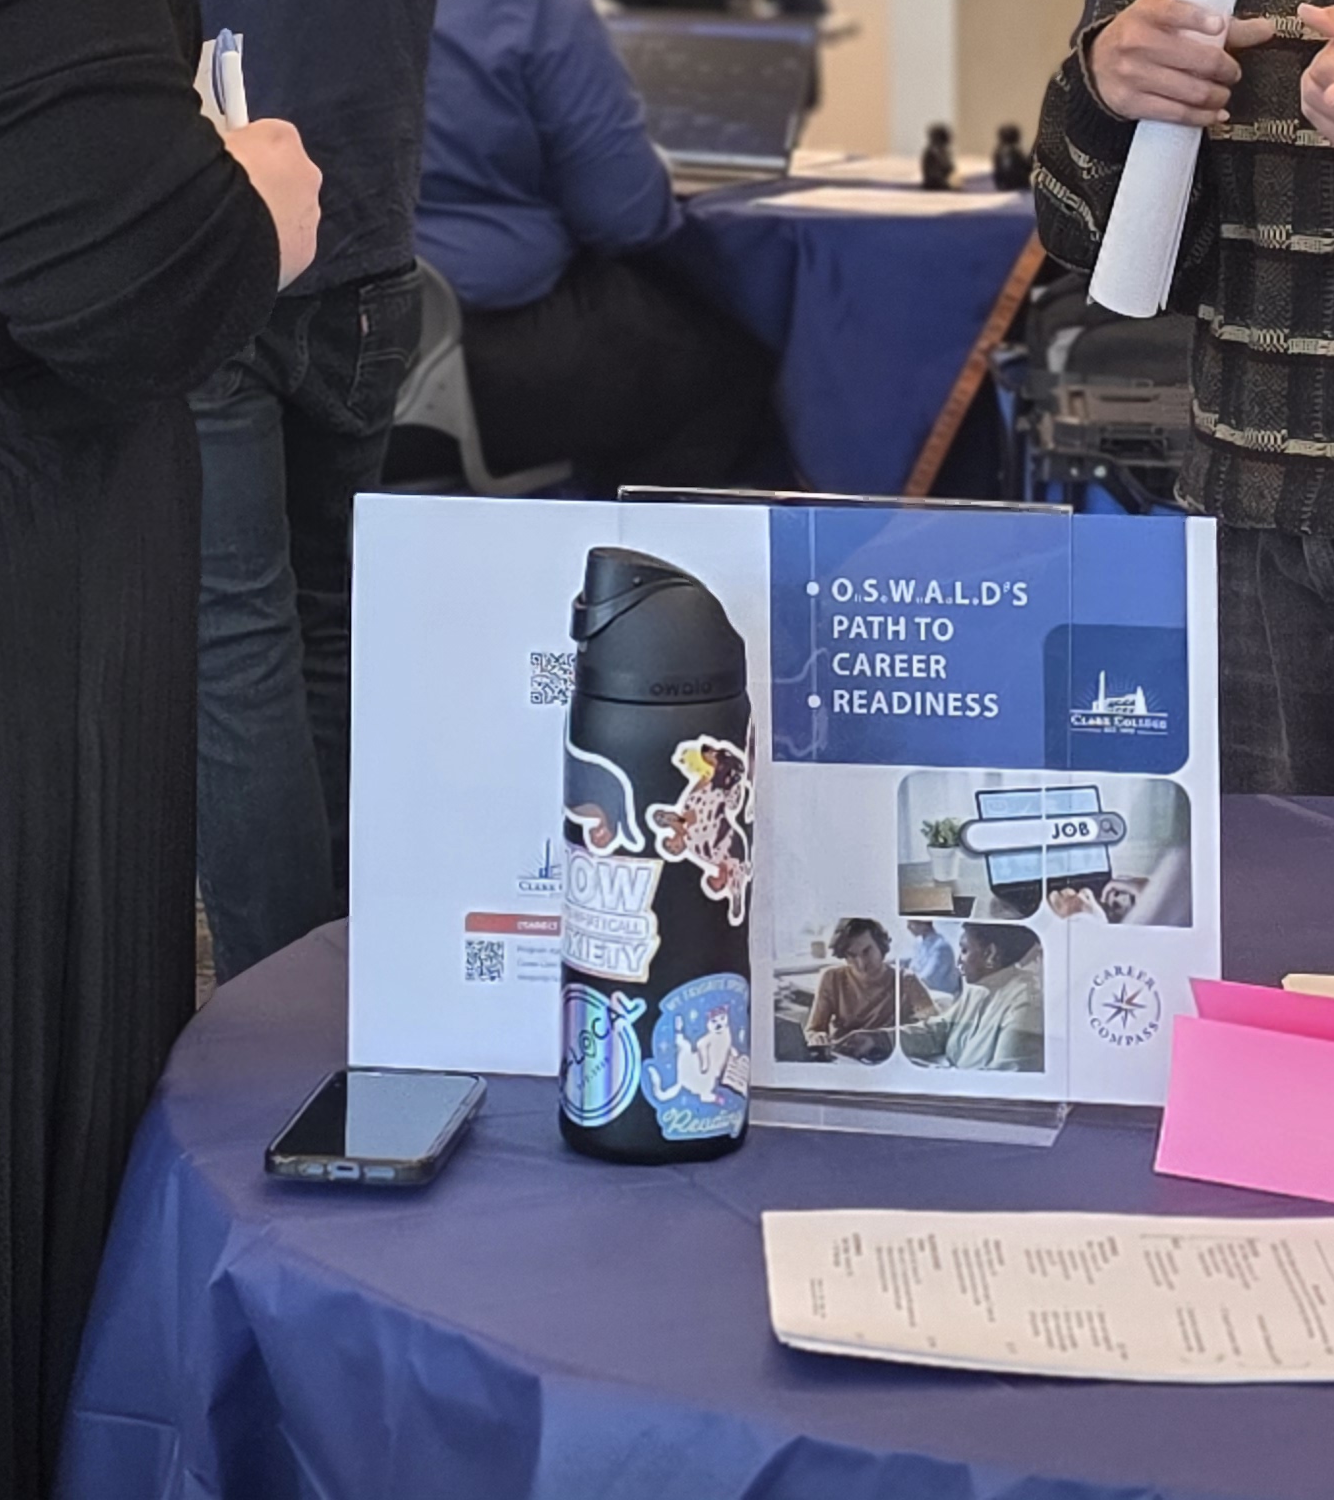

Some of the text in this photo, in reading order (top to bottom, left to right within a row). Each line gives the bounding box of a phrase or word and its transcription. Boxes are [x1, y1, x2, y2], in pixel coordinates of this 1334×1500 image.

[833, 615, 954, 642] PATH TO
[832, 652, 947, 679] CAREER
[833, 689, 999, 718] READINESS
[1051, 821, 1090, 840] JOB
[1093, 965, 1156, 991] CAREER
[1090, 1017, 1159, 1046] COMPASS
